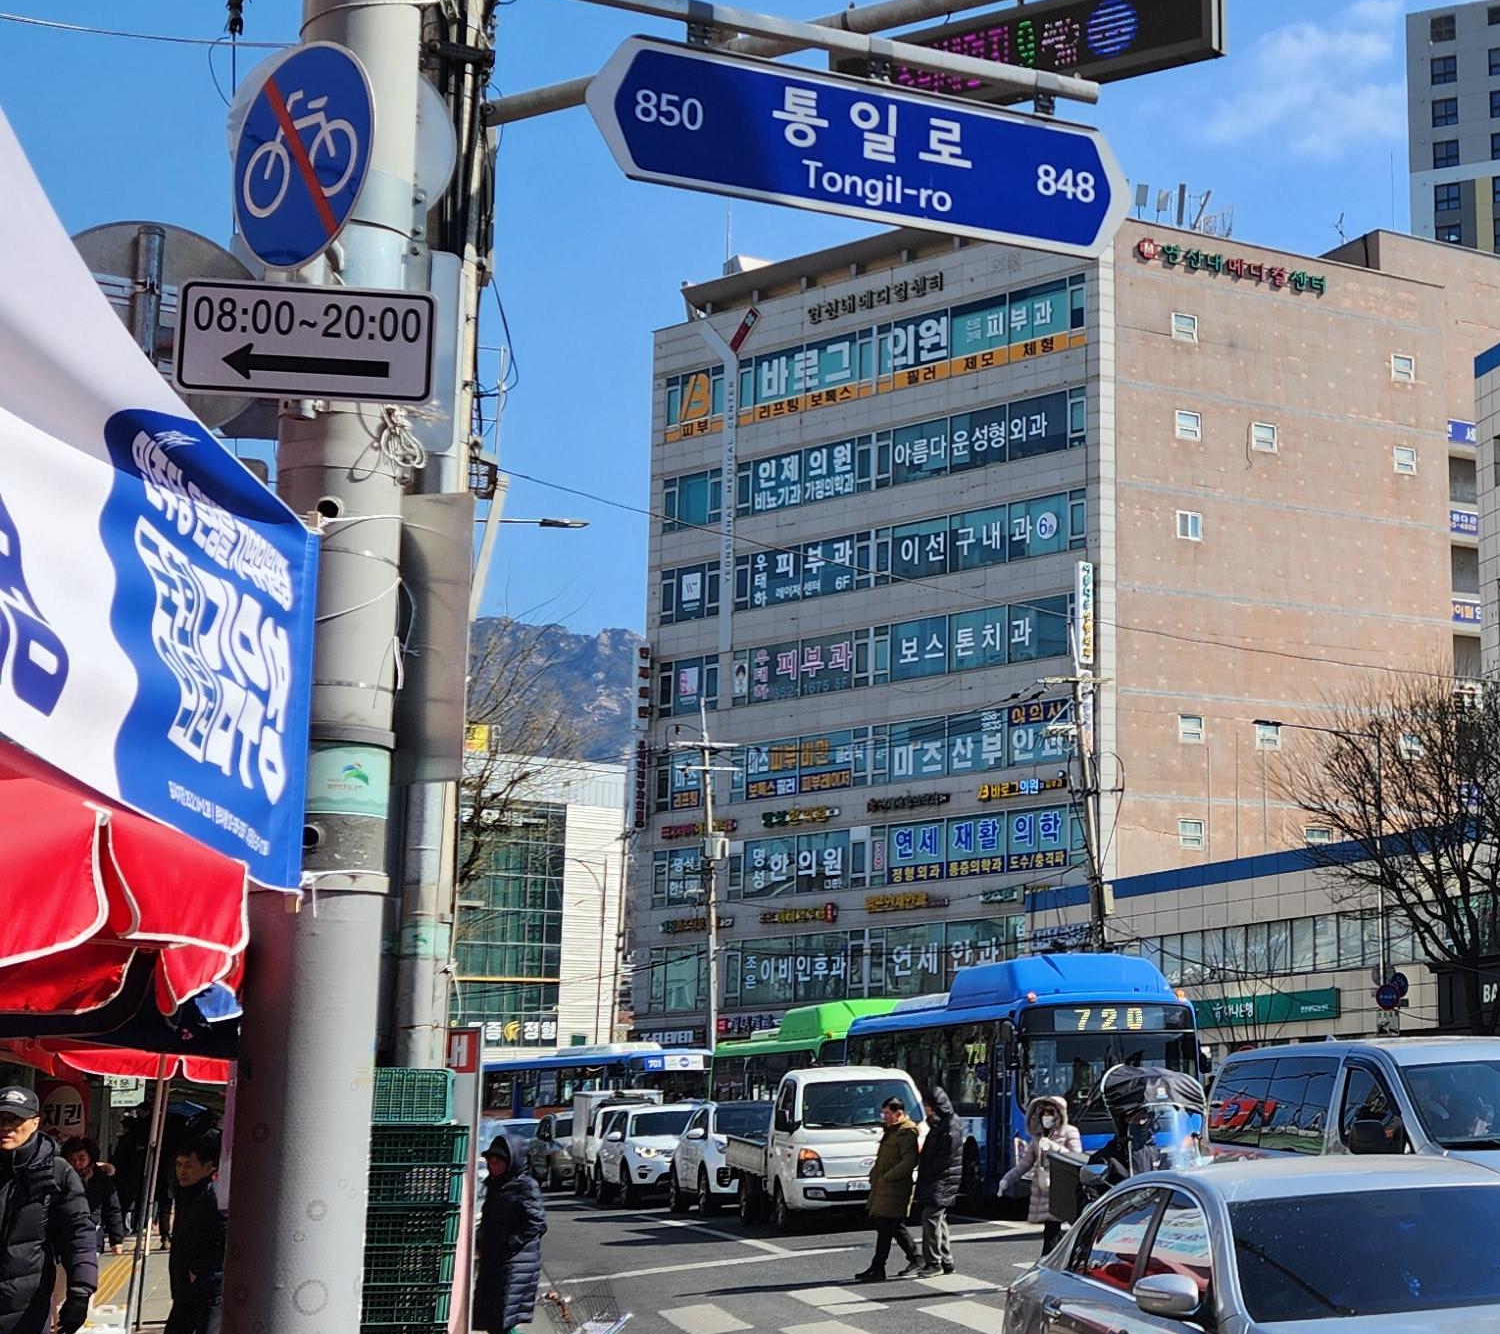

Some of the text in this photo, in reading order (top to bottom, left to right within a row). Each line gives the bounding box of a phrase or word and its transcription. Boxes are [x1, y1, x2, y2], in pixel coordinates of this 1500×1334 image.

[634, 89, 703, 131] 850
[772, 86, 972, 169] 통일로
[801, 159, 951, 213] Tongil-ro
[1036, 165, 1095, 203] 848
[194, 296, 421, 343] 08:00~20:00
[987, 299, 1053, 339] 피부과
[761, 316, 948, 398] 바로그 의원
[894, 412, 1048, 467] 아름다운성형외과
[775, 540, 852, 578] 피부과
[835, 575, 850, 590] 6F
[776, 641, 853, 681] 피부과
[899, 617, 1032, 664] 보스톤치과
[770, 847, 843, 881] 한의원
[1074, 1007, 1142, 1031] 720
